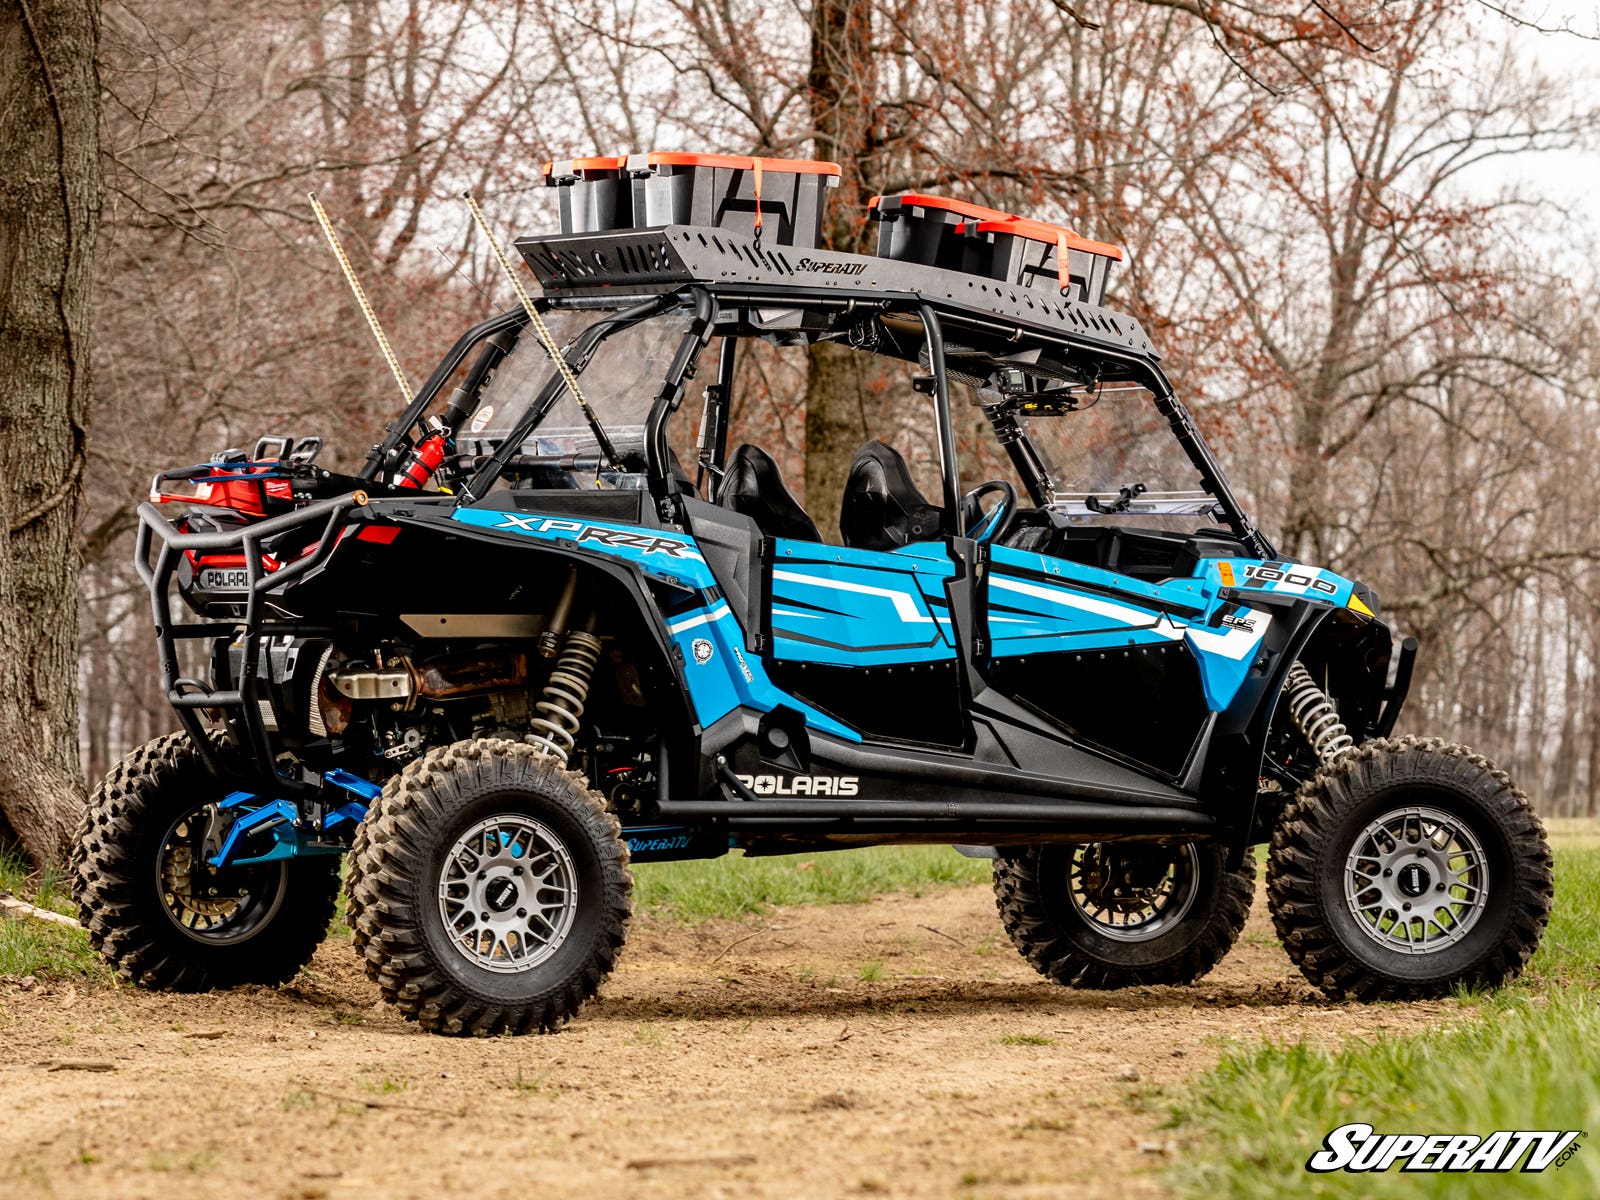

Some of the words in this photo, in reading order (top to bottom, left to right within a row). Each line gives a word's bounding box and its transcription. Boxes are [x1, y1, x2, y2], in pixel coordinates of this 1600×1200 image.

[795, 258, 867, 275] SUPERATV
[491, 514, 583, 532] XP
[575, 526, 688, 559] RZR
[207, 572, 248, 587] POLARI
[1243, 565, 1338, 596] 1000
[1222, 615, 1256, 628] EPS
